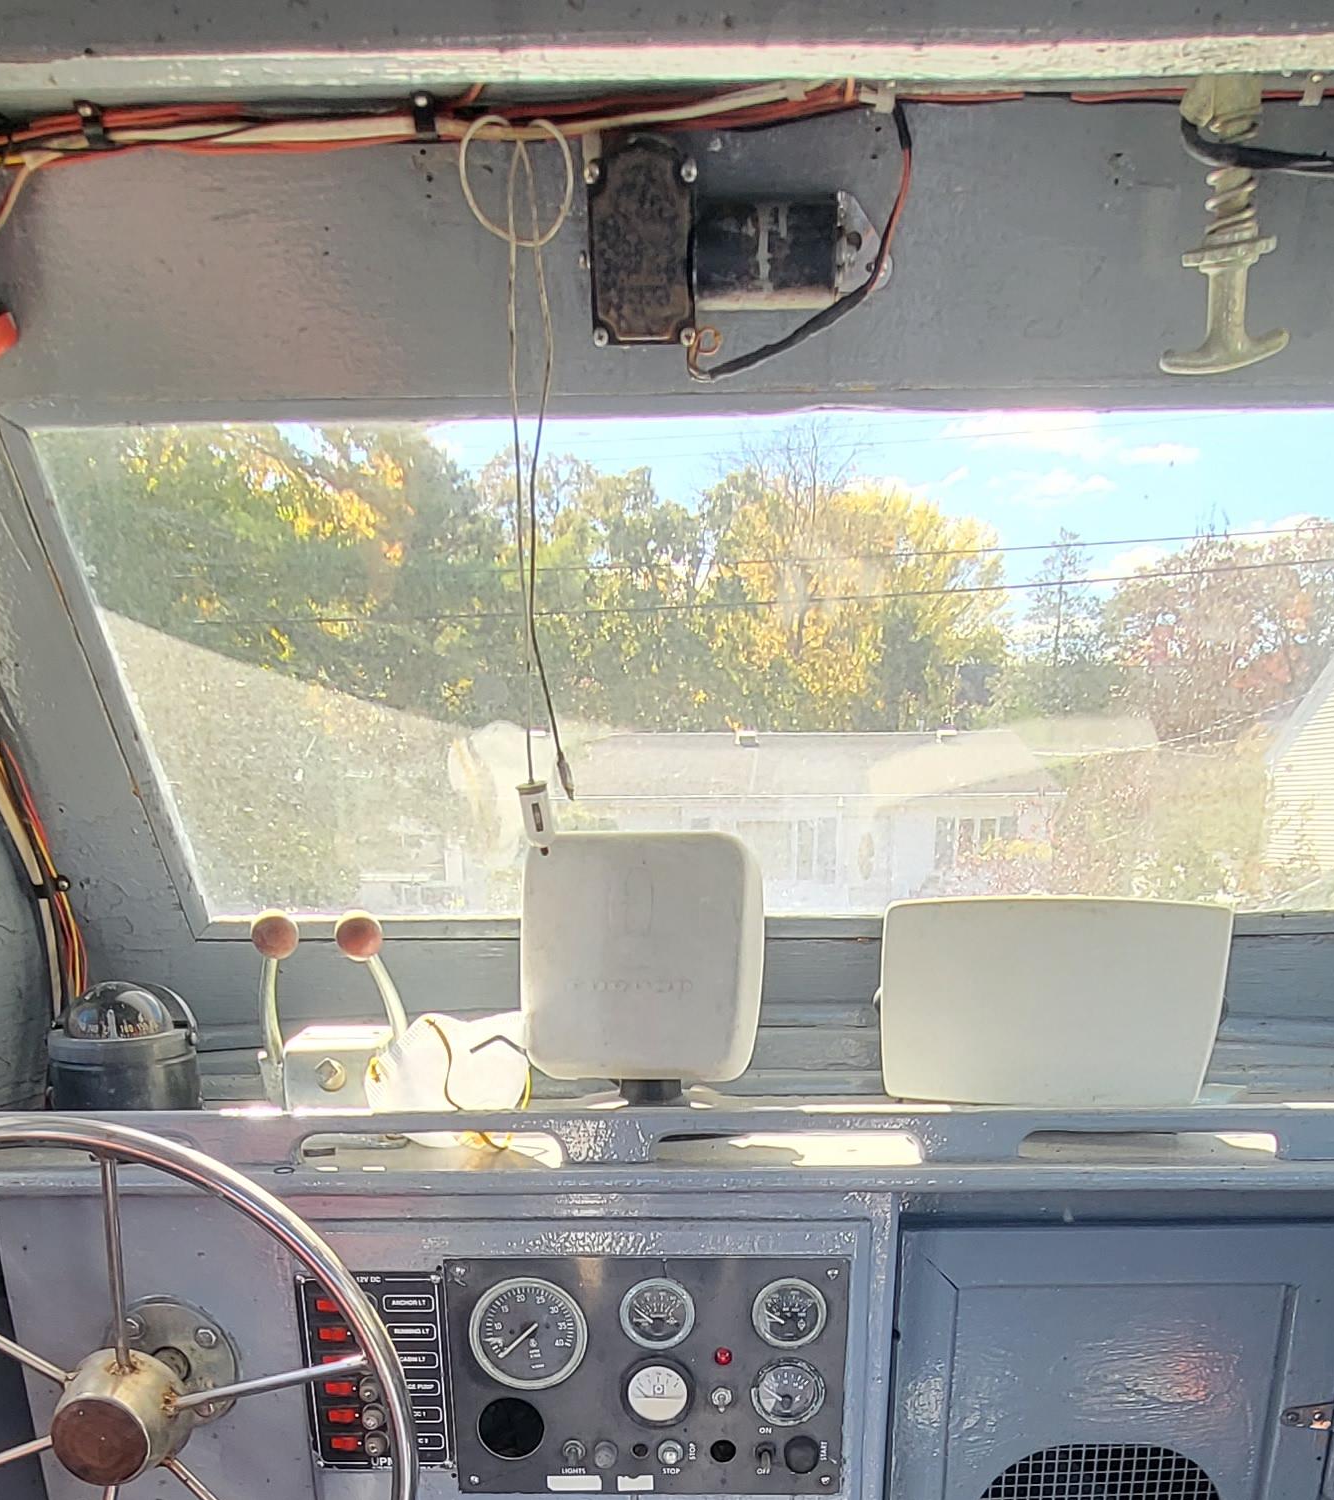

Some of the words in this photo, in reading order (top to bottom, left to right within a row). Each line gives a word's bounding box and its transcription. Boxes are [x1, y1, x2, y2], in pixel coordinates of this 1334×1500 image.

[516, 1294, 526, 1303] 20
[536, 1295, 546, 1304] 25
[501, 1304, 509, 1313] 15
[550, 1305, 559, 1314] 30
[494, 1322, 503, 1330] 10
[557, 1322, 566, 1330] 35
[554, 1339, 564, 1347] 40
[689, 1442, 697, 1460] STOP
[820, 1441, 828, 1461] START
[561, 1467, 586, 1475] LIGHTS
[662, 1467, 681, 1475] STOP
